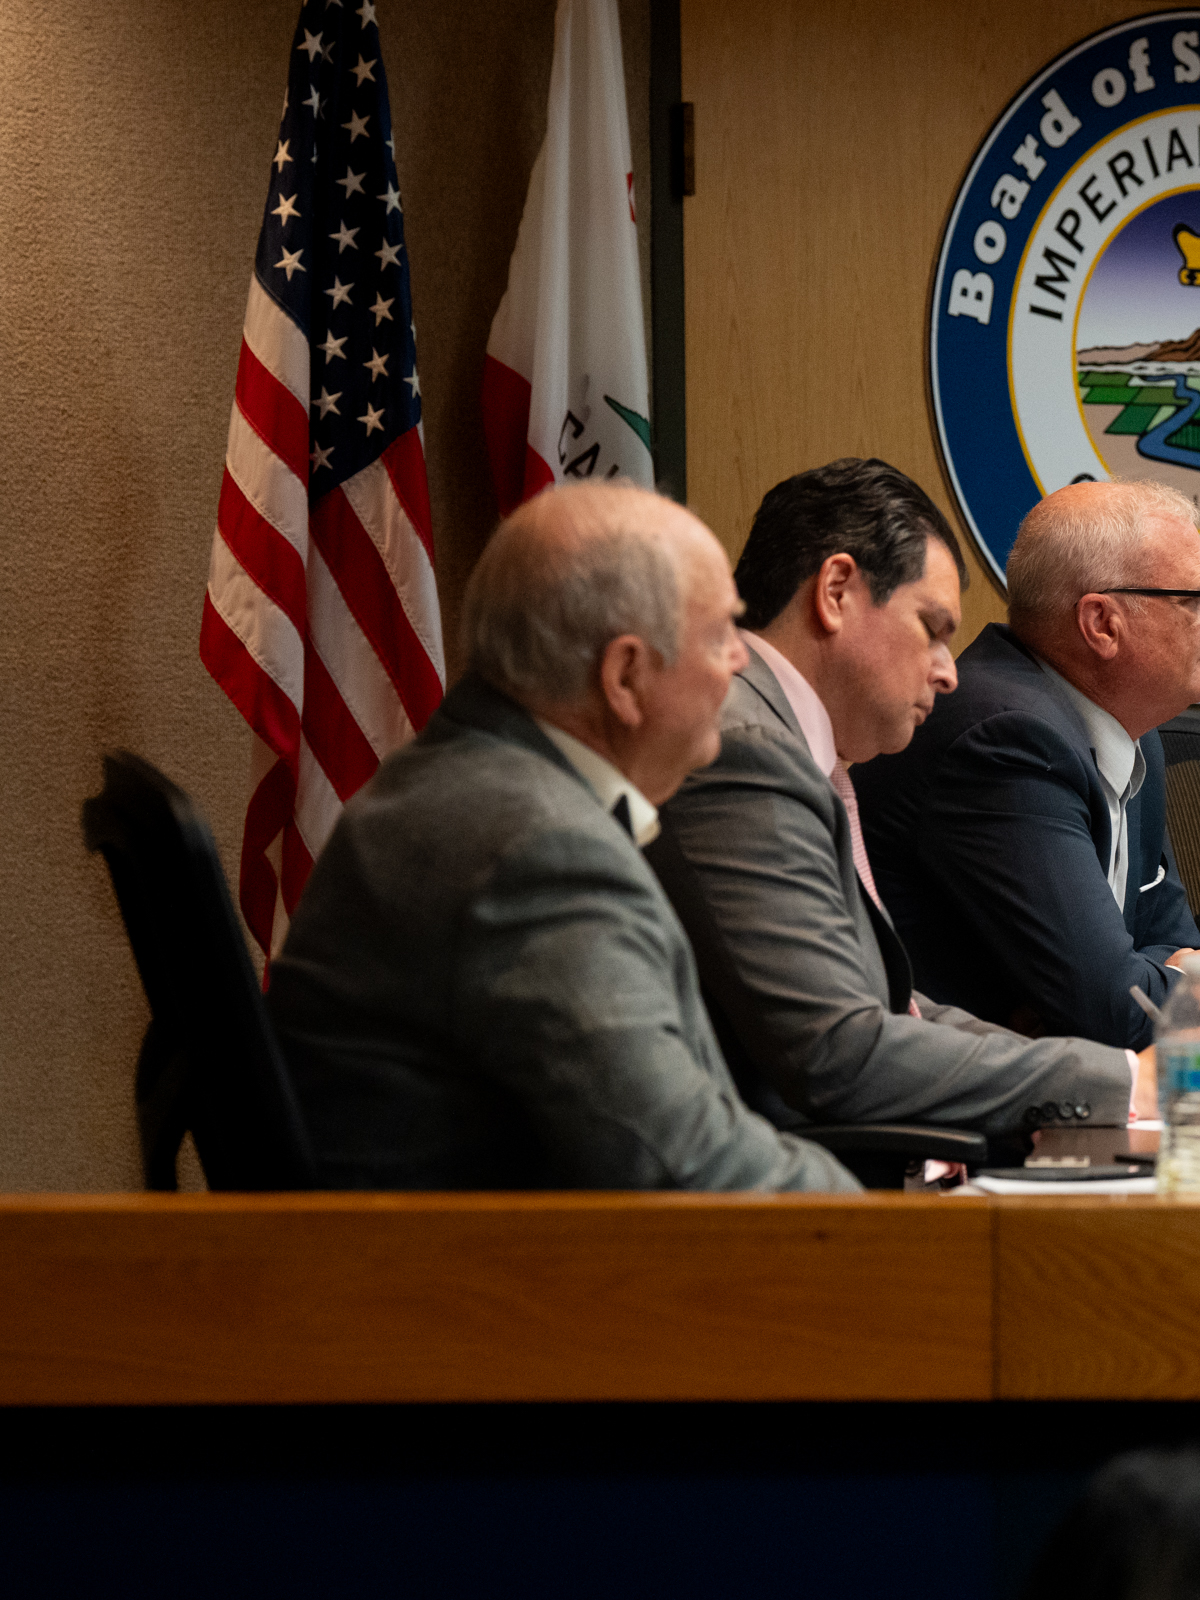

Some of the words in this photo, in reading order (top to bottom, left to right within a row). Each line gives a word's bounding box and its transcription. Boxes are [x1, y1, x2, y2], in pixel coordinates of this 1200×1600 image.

[947, 88, 1082, 326] Board
[1091, 38, 1155, 108] of
[557, 409, 620, 479] CA
